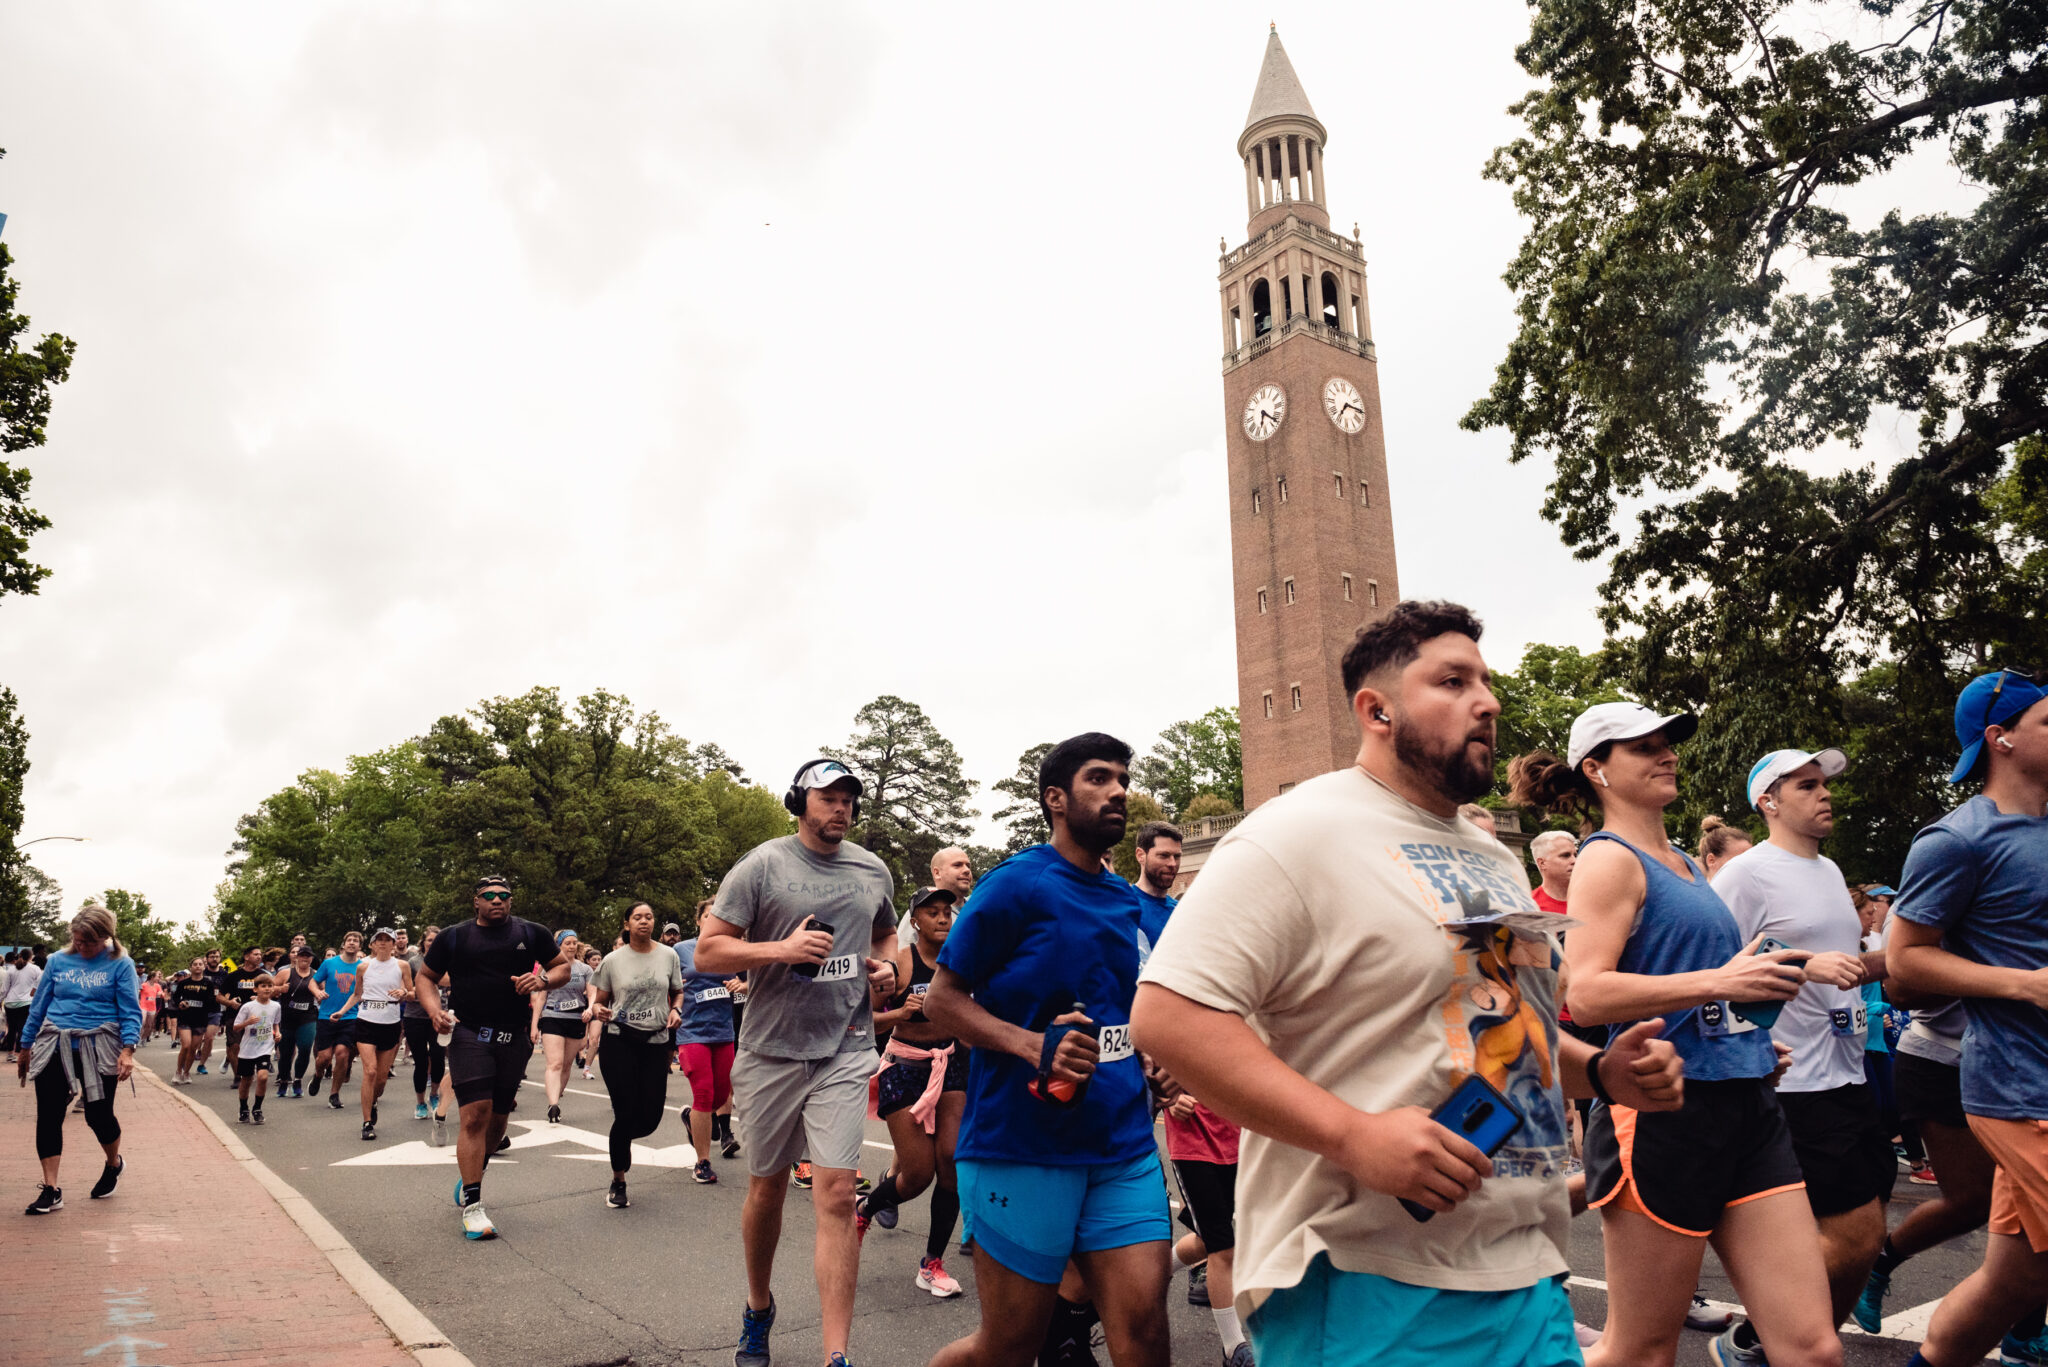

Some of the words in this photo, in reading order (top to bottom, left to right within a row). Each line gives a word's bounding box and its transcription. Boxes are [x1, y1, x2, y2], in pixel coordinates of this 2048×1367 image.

[1400, 843, 1457, 861] SON
[787, 881, 873, 896] CAROLINA
[707, 987, 726, 998] 8441
[368, 1001, 385, 1010] 7383
[629, 1010, 652, 1021] 8294
[496, 1031, 513, 1043] 213
